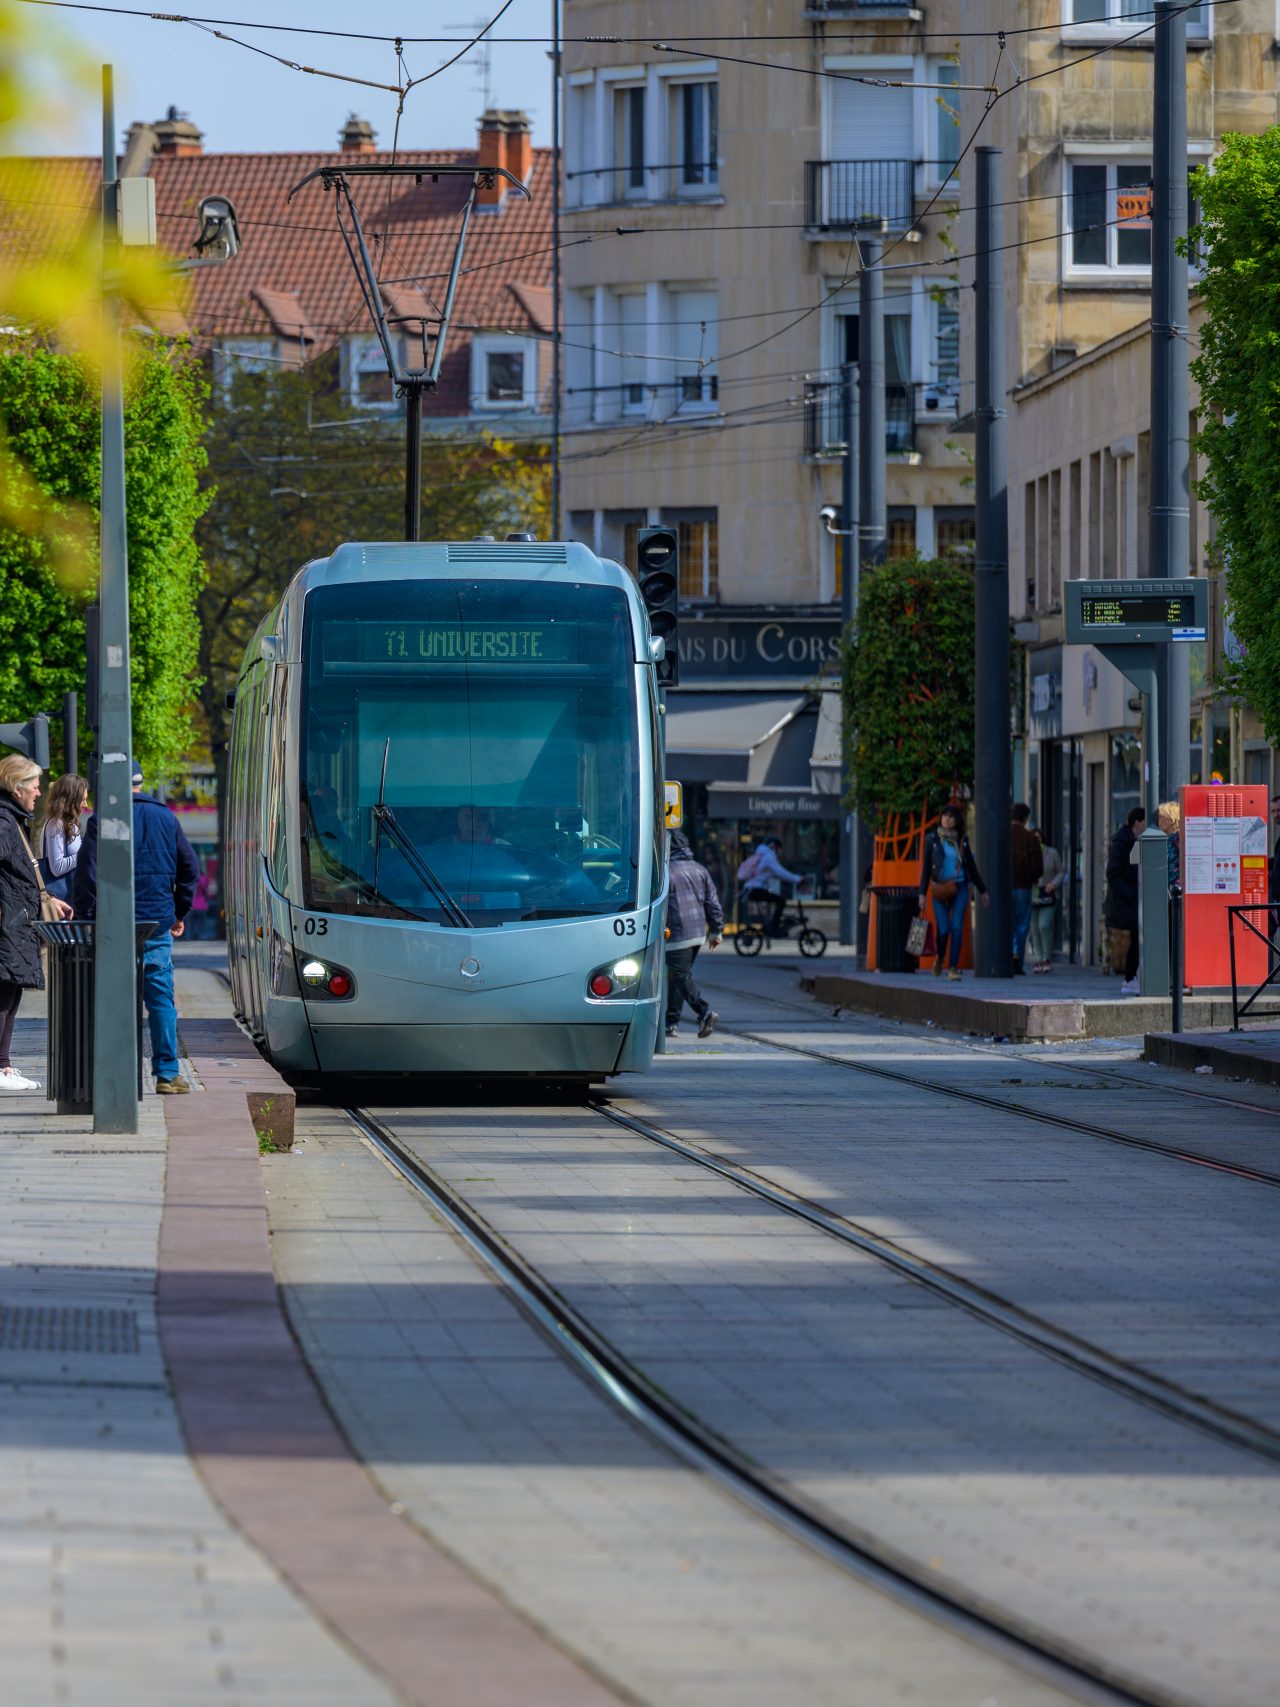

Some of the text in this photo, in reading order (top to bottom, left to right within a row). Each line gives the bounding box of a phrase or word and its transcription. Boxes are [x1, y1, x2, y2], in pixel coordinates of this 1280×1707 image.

[384, 631, 543, 657] T1 UNIVERSITE
[713, 637, 746, 663] DU
[304, 917, 328, 936] 03
[613, 918, 636, 936] 03
